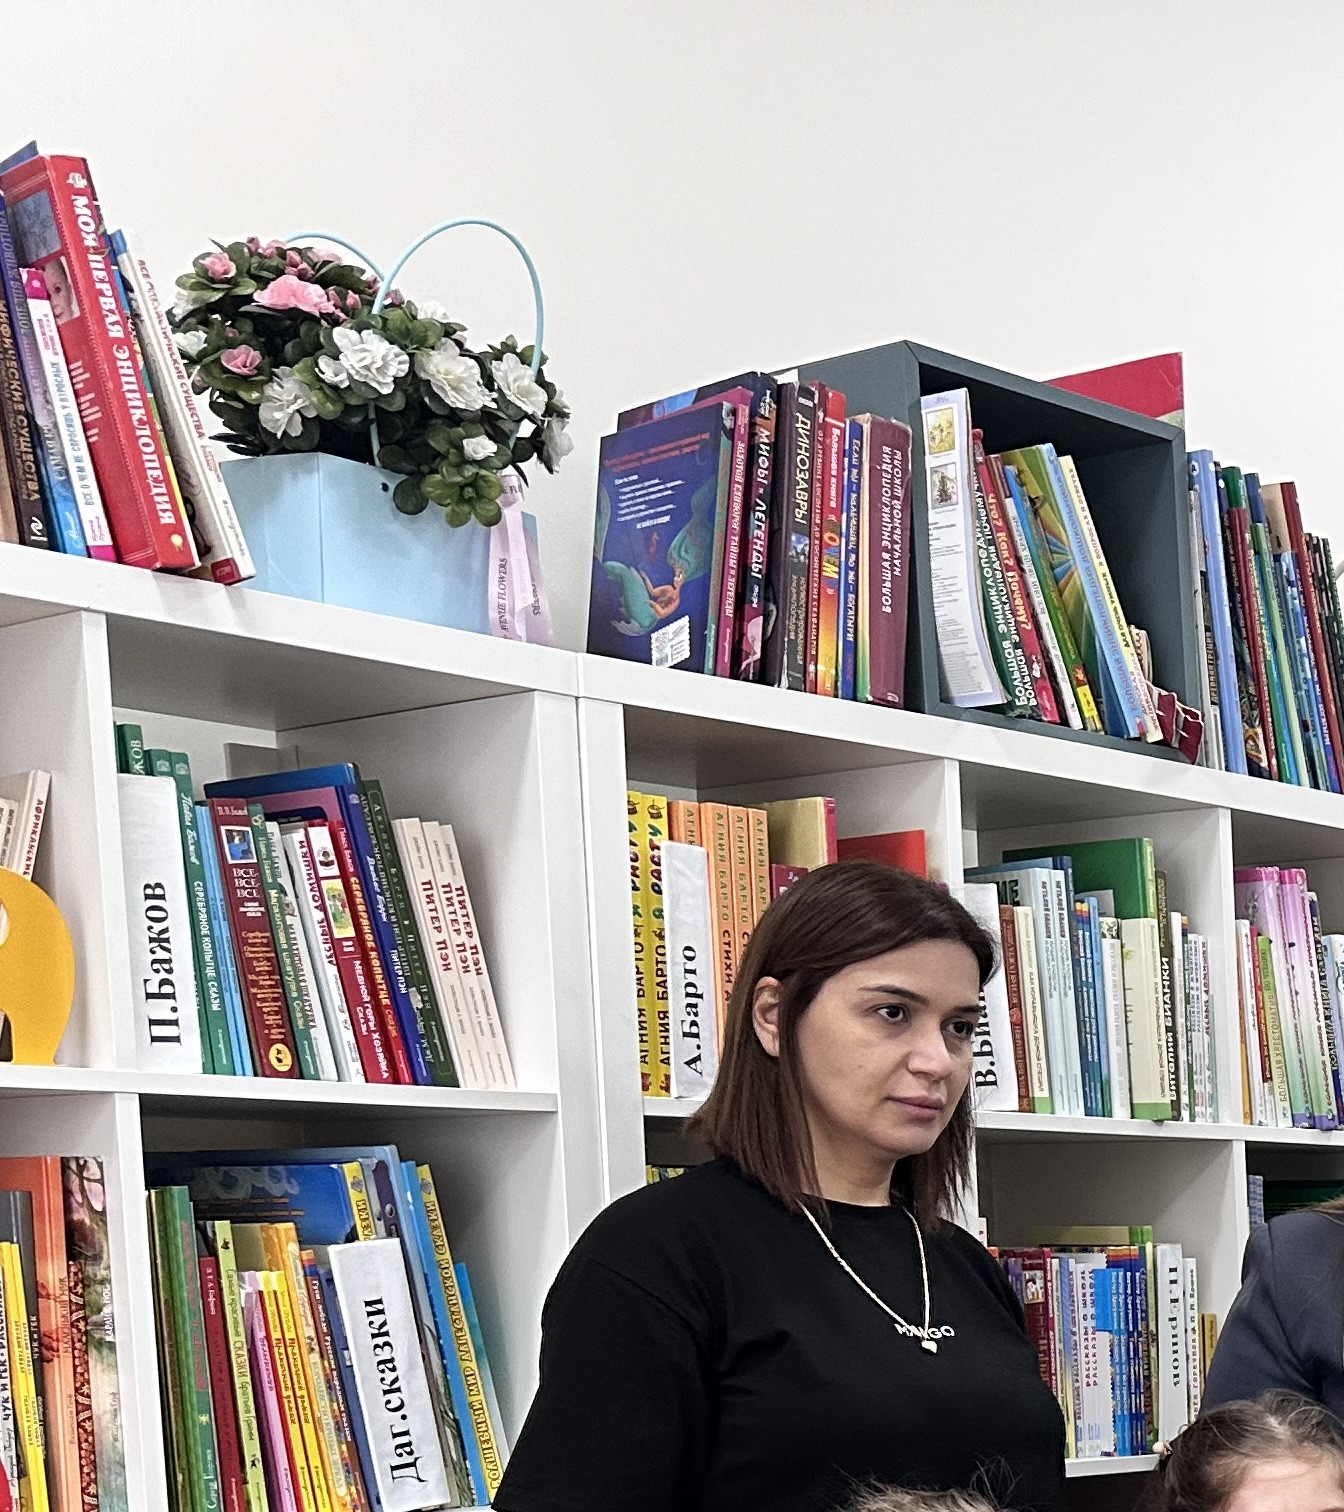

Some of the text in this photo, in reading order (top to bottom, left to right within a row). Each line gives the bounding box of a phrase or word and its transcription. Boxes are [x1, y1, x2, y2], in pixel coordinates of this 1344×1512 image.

[69, 191, 176, 528] МОЯ ПЕРВАЯ ЭНЦИКЛОПЕДИЯ
[178, 380, 204, 439] СУЩЕСТВА
[15, 413, 41, 501] СУЩЕСТВА
[749, 427, 771, 579] МИФЫ ЛЕГЕНДЫ
[789, 412, 812, 524] ДИНОЗАВРЫ
[892, 448, 903, 576] НАЧАЛЬНОЙ ШКОЛЫ
[880, 444, 892, 613] БОЛЬШАЯ ЭНЦИКЛОПЕДИЯ
[985, 492, 1032, 632] Что? Как? Почему?
[296, 838, 324, 914] ДОМИШКИ
[714, 811, 734, 985] АГНИЯ БАРТО СТИХИ
[735, 813, 750, 924] АГНИЯ БАРТО
[755, 817, 766, 869] АГНИЯ
[137, 879, 182, 1049] П.Бажов
[193, 880, 221, 1012] СЕРЕБРЯНОЕ СКАЗЫ
[348, 875, 390, 1007] СЕРЕБРЯНОЕ КОПЫТЦЕ
[420, 879, 452, 973] ПИТЕР ПЭН
[440, 882, 472, 975] ПИТЕР ПЭН
[453, 885, 483, 977] ПИТЕР ПЭН
[362, 1002, 390, 1079] ГОРЫ ХОЗЯЙКА
[395, 975, 408, 995] ПЭН
[656, 944, 671, 1067] АГНИЯ БАРТО
[681, 944, 704, 1077] А.Барто
[1160, 955, 1174, 1026] БИАНКИ
[1265, 992, 1288, 1102] БОЛЬШАЯ ХРЕСТОМАТИЯ
[29, 1314, 39, 1359] ЧУК ГЕК
[57, 1275, 67, 1296] МУК
[1079, 1269, 1092, 1387] РАССКАЗЫ О ШКОЛЕ
[1165, 1265, 1182, 1387] П.Ершов
[232, 1339, 247, 1379] СКАЗКИ
[353, 1293, 428, 1489] Даг.сказки
[423, 1200, 504, 1490] ВОЛШЕБНЫЙ МИР ДАГЕСТАНСКОЙ СКАЗКИ
[1089, 1325, 1099, 1387] РАССКАЗЫ
[1, 1395, 11, 1420] ЧУК
